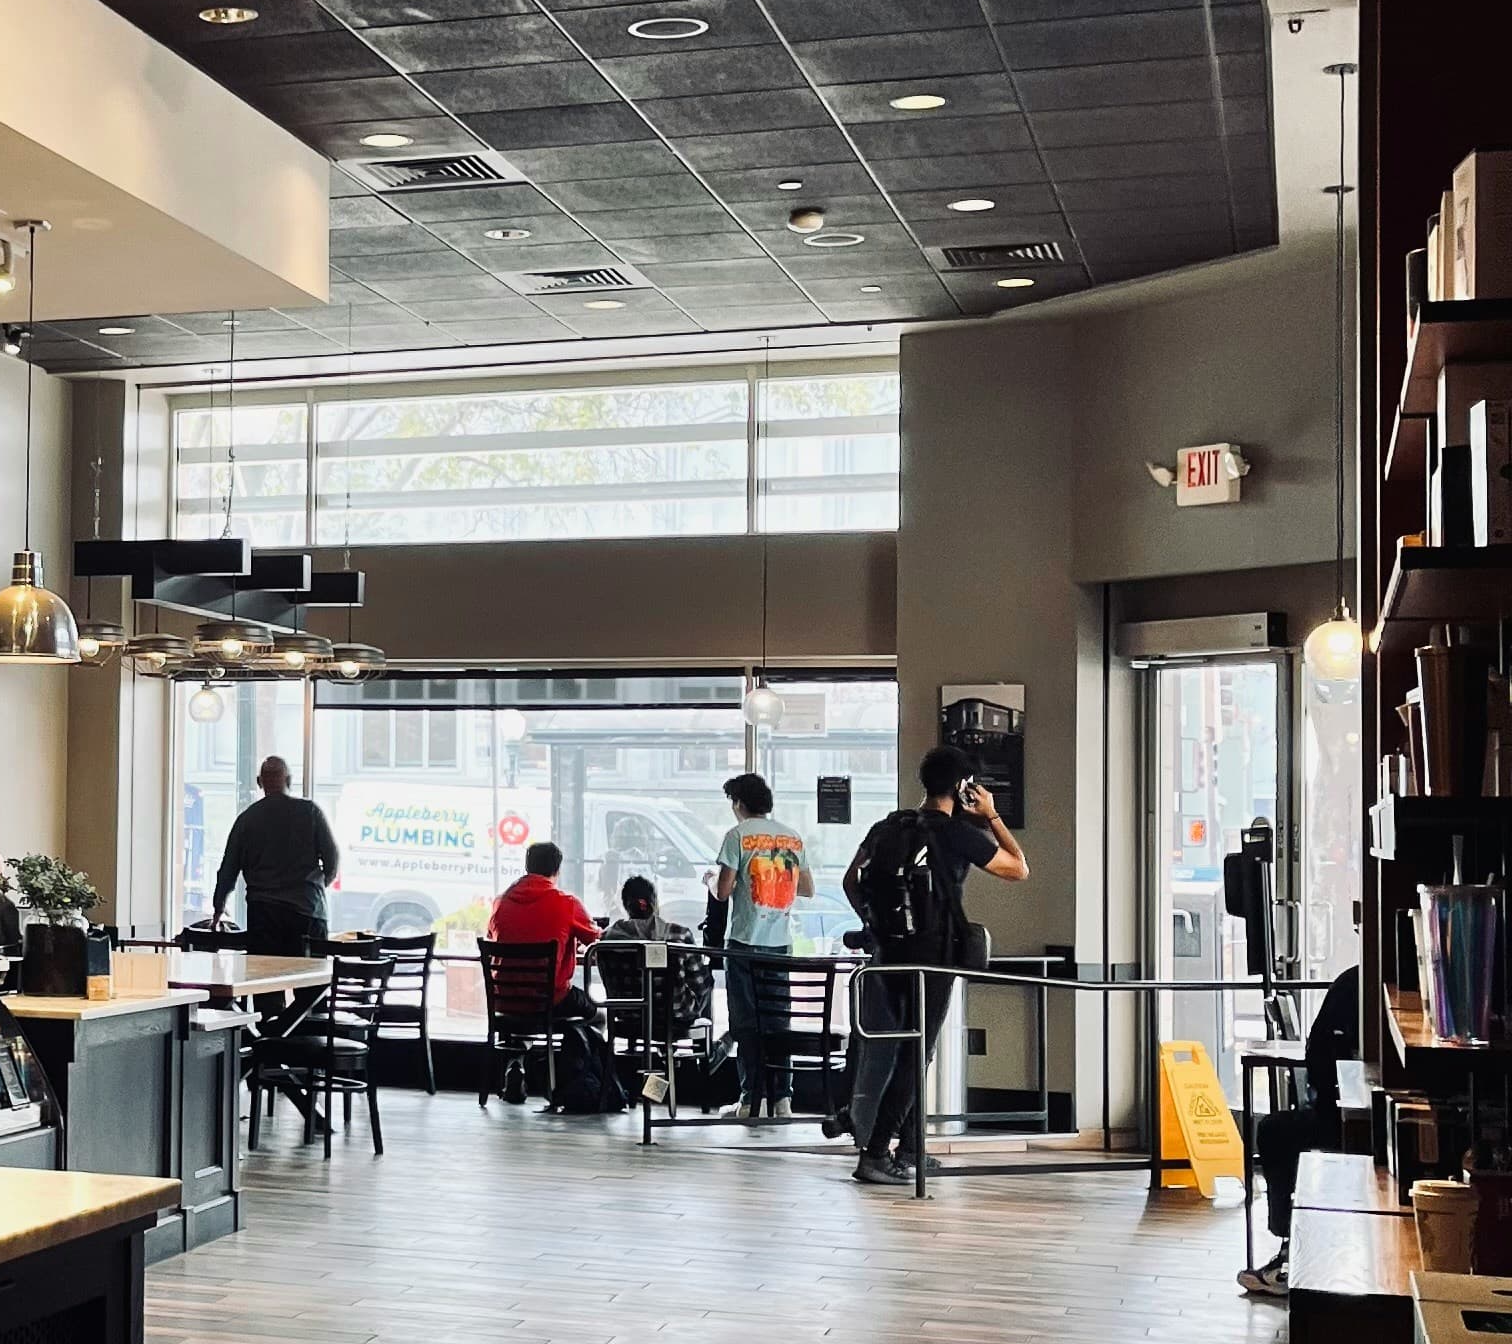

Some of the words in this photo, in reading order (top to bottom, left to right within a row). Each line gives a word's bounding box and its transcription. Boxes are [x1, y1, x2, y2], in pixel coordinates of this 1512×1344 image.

[1187, 450, 1221, 488] EXIT
[367, 802, 471, 827] Appleberry
[360, 825, 476, 849] PLUMBING
